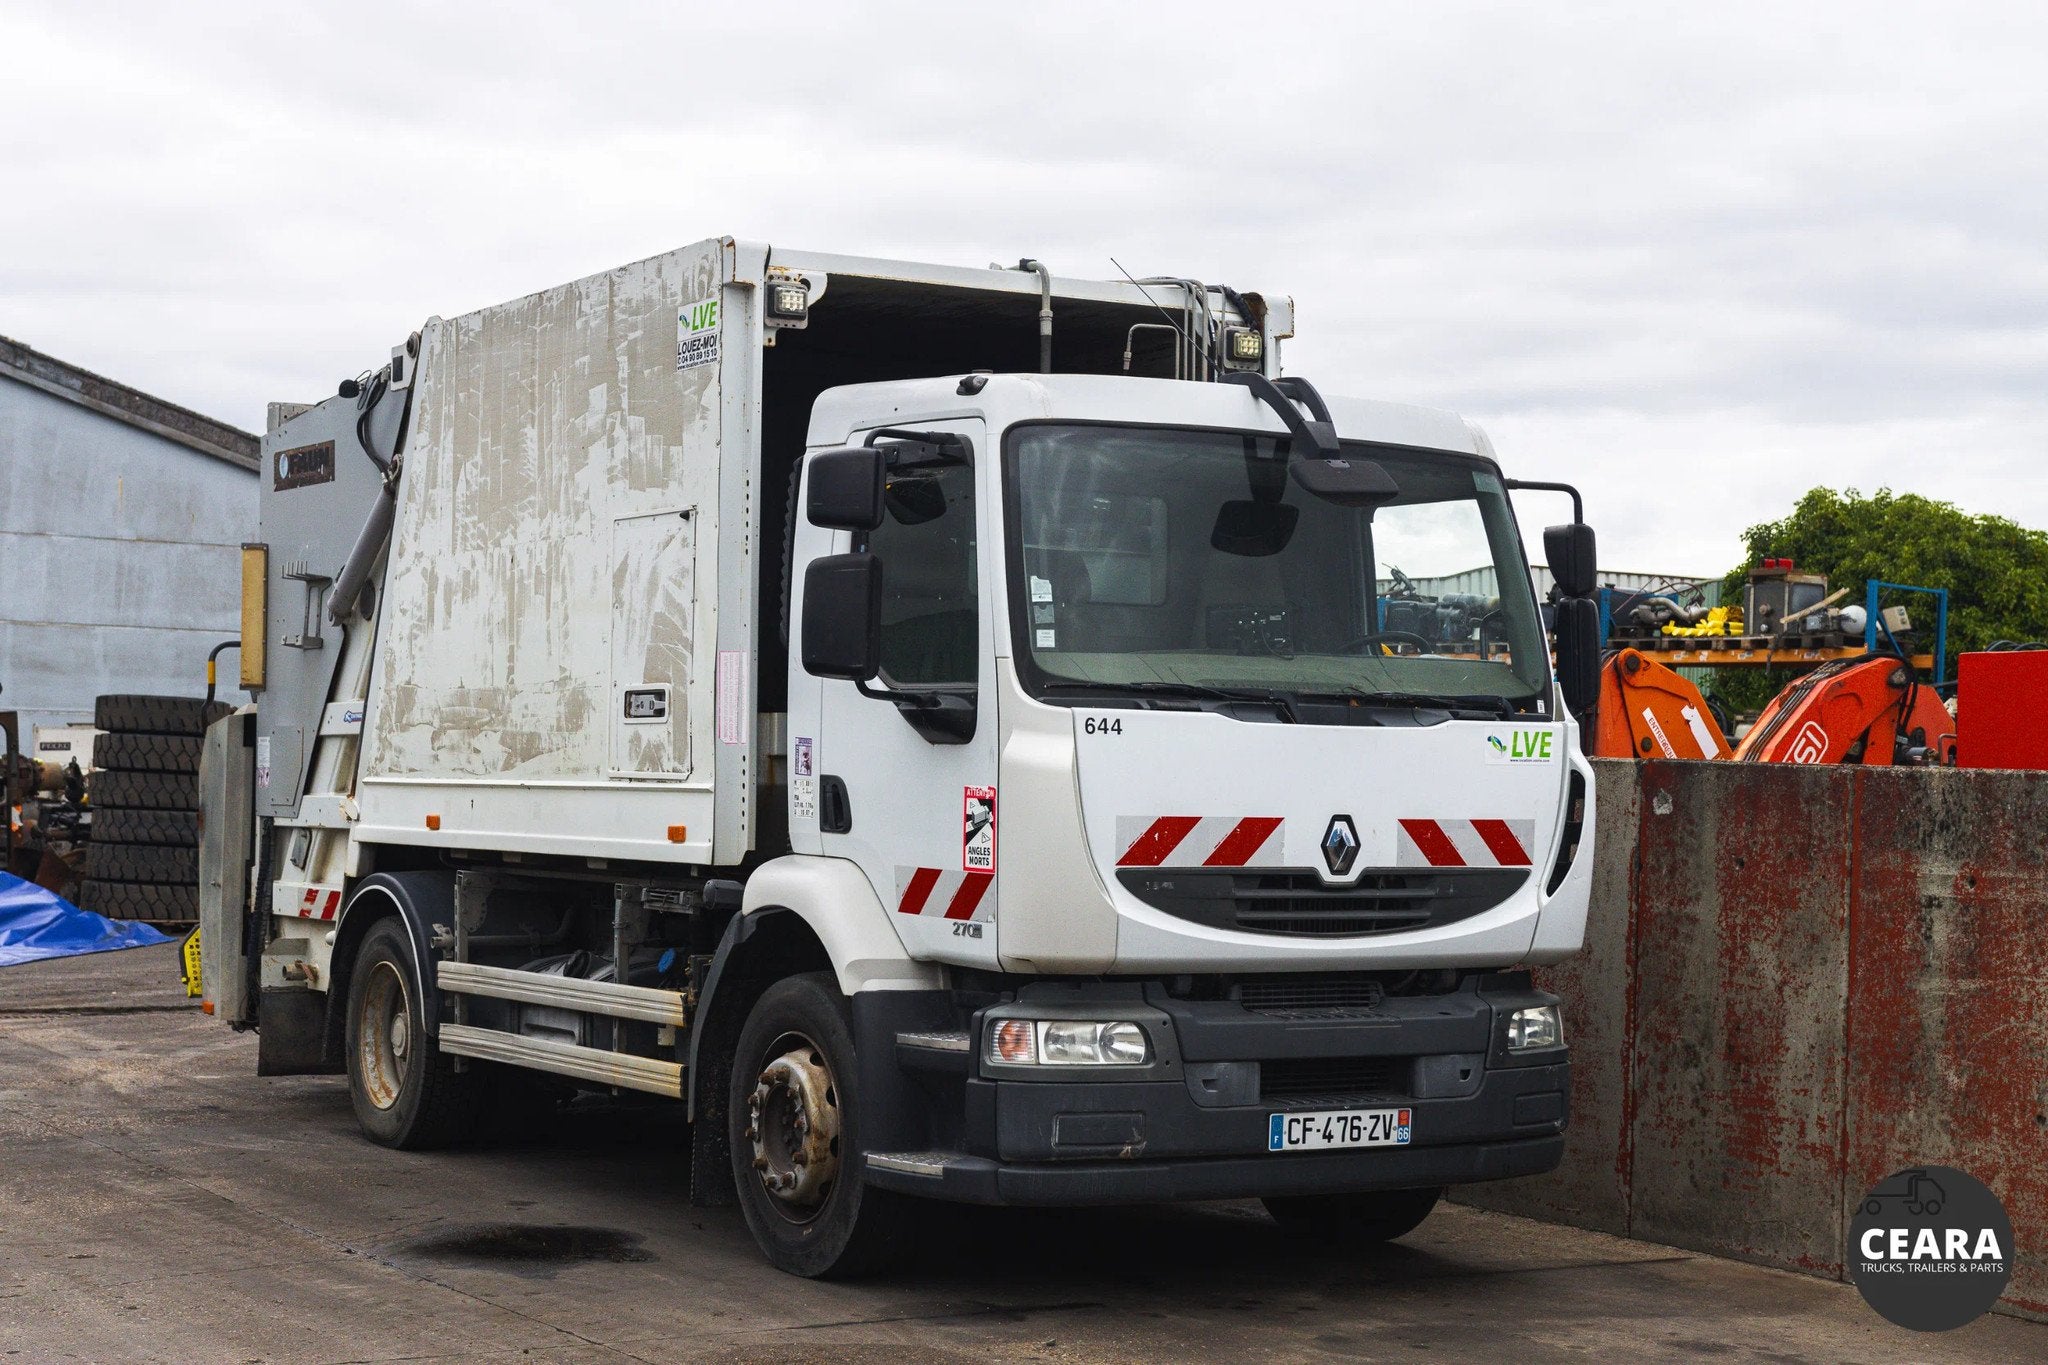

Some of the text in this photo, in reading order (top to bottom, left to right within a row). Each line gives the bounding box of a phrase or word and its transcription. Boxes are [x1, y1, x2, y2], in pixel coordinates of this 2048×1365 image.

[692, 302, 717, 331] LVE
[677, 334, 717, 356] LOUEZ-MOI
[682, 356, 688, 364] 04
[704, 349, 710, 358] 15
[1085, 717, 1122, 735] 644
[1511, 731, 1553, 757] LVE
[968, 846, 991, 856] ANGLES
[969, 856, 990, 866] MORTS
[952, 922, 974, 938] 270
[1274, 1114, 1409, 1145] F CF-476-ZV 66
